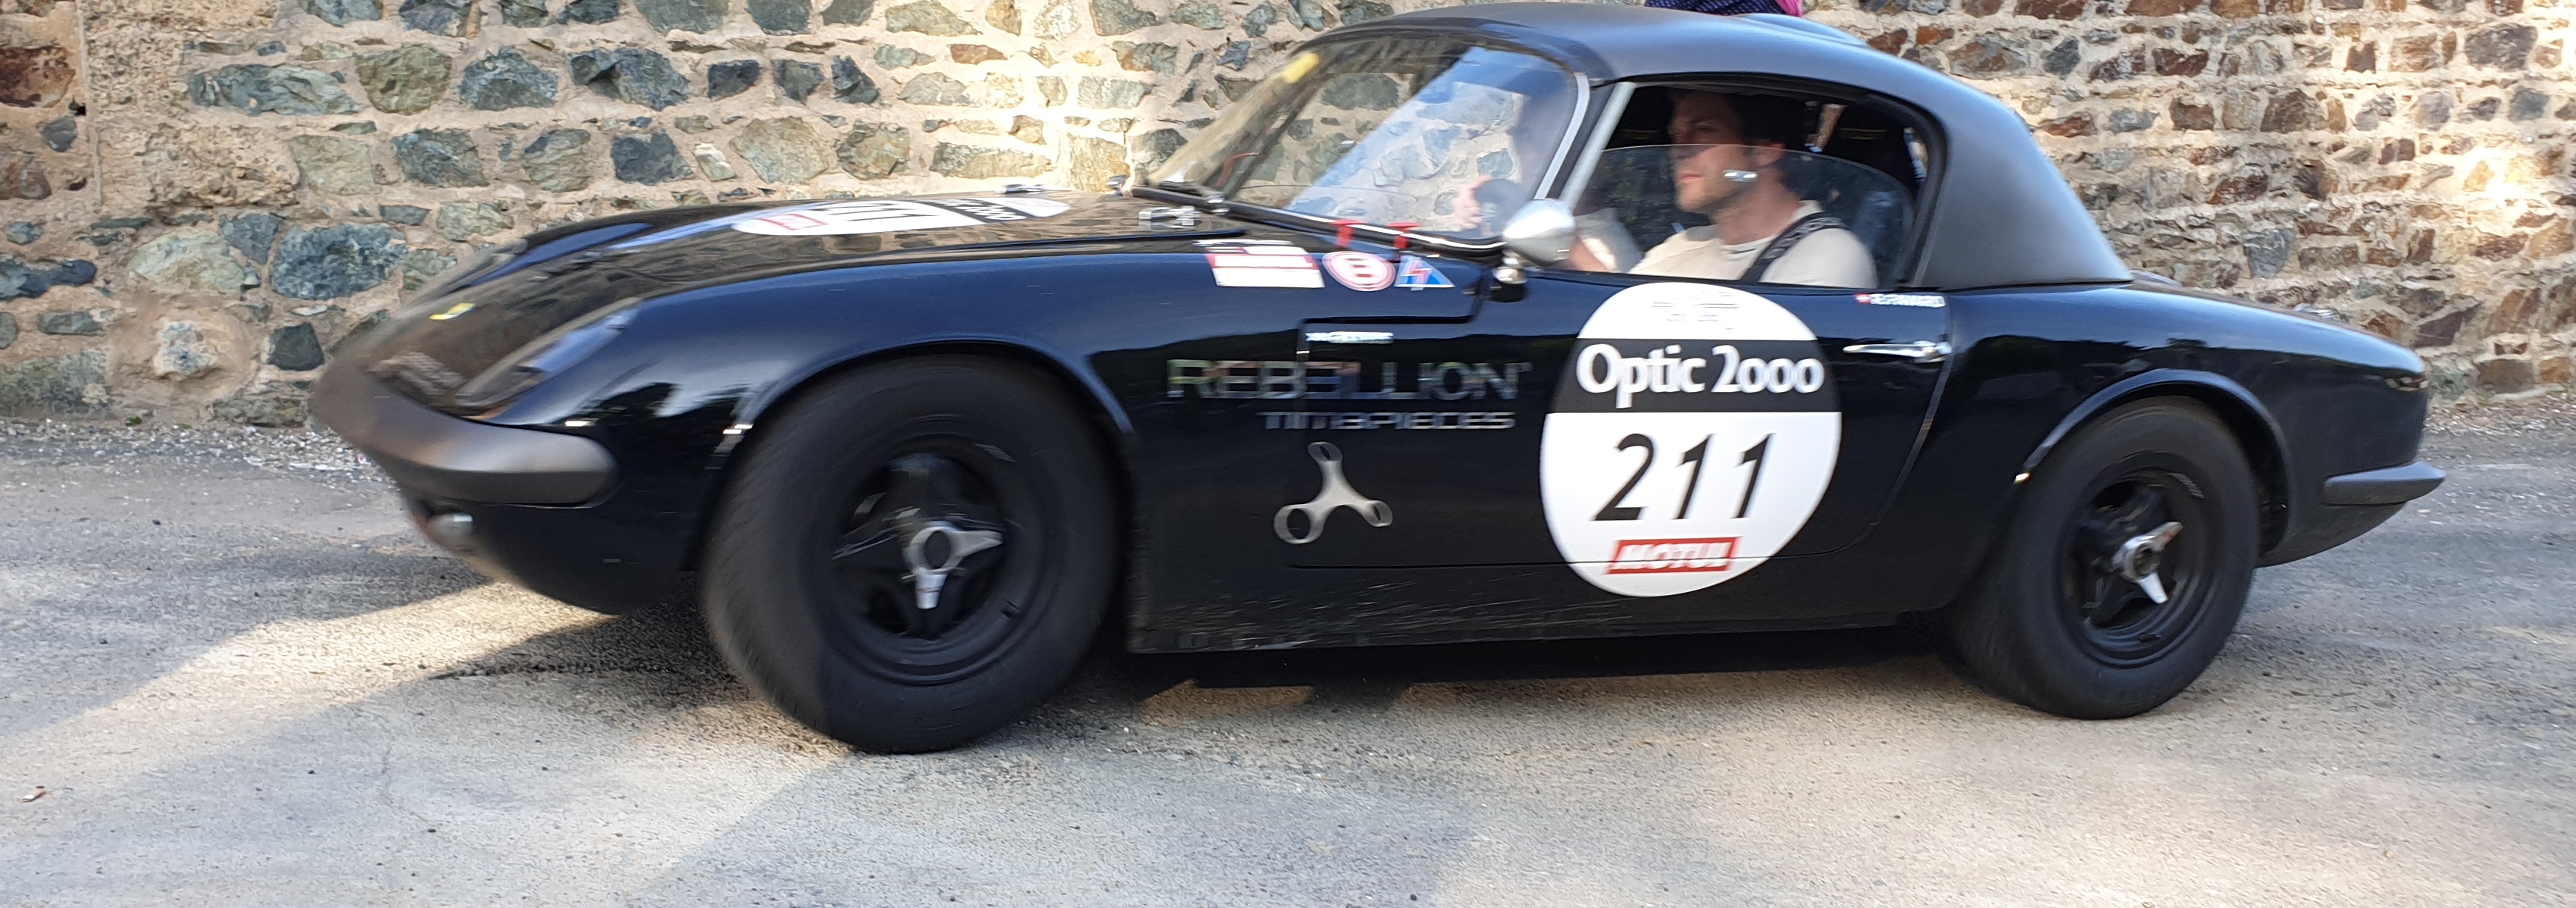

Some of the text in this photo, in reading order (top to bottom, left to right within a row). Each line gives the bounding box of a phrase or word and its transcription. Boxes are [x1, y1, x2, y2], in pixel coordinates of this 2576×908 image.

[1577, 344, 1824, 409] Optic 2000
[1590, 433, 1776, 521] 211
[1610, 541, 1734, 569] MOTUL
